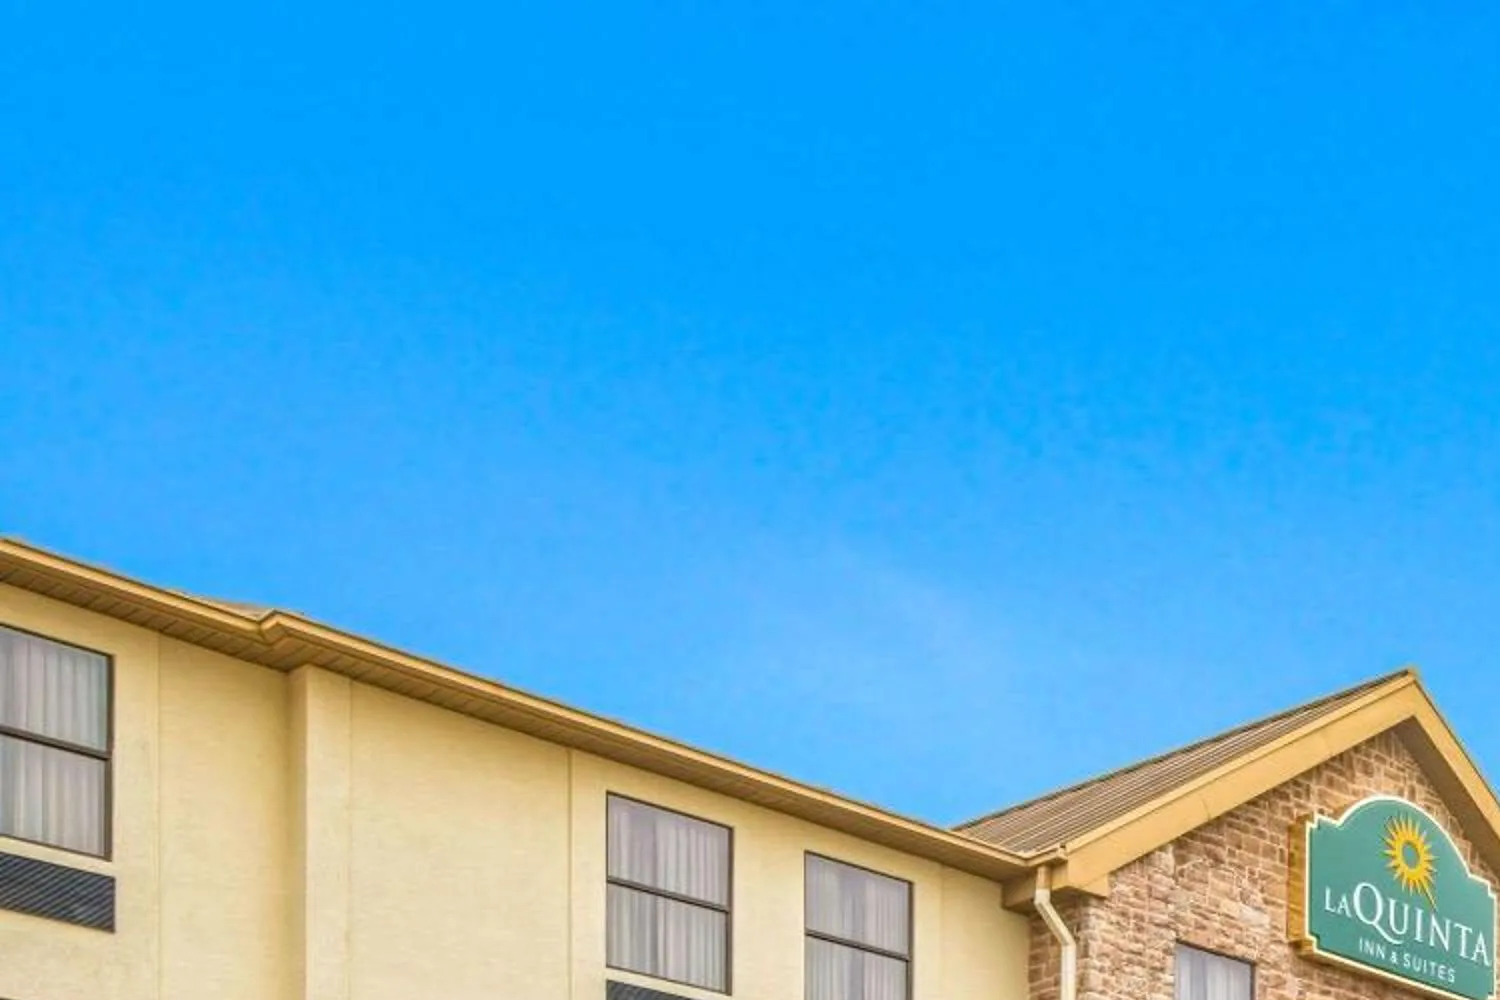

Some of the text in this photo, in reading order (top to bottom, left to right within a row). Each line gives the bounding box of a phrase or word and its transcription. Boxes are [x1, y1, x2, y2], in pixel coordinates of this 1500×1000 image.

[1324, 882, 1491, 967] LA QUINTA
[1359, 937, 1455, 983] INN & SUITES
